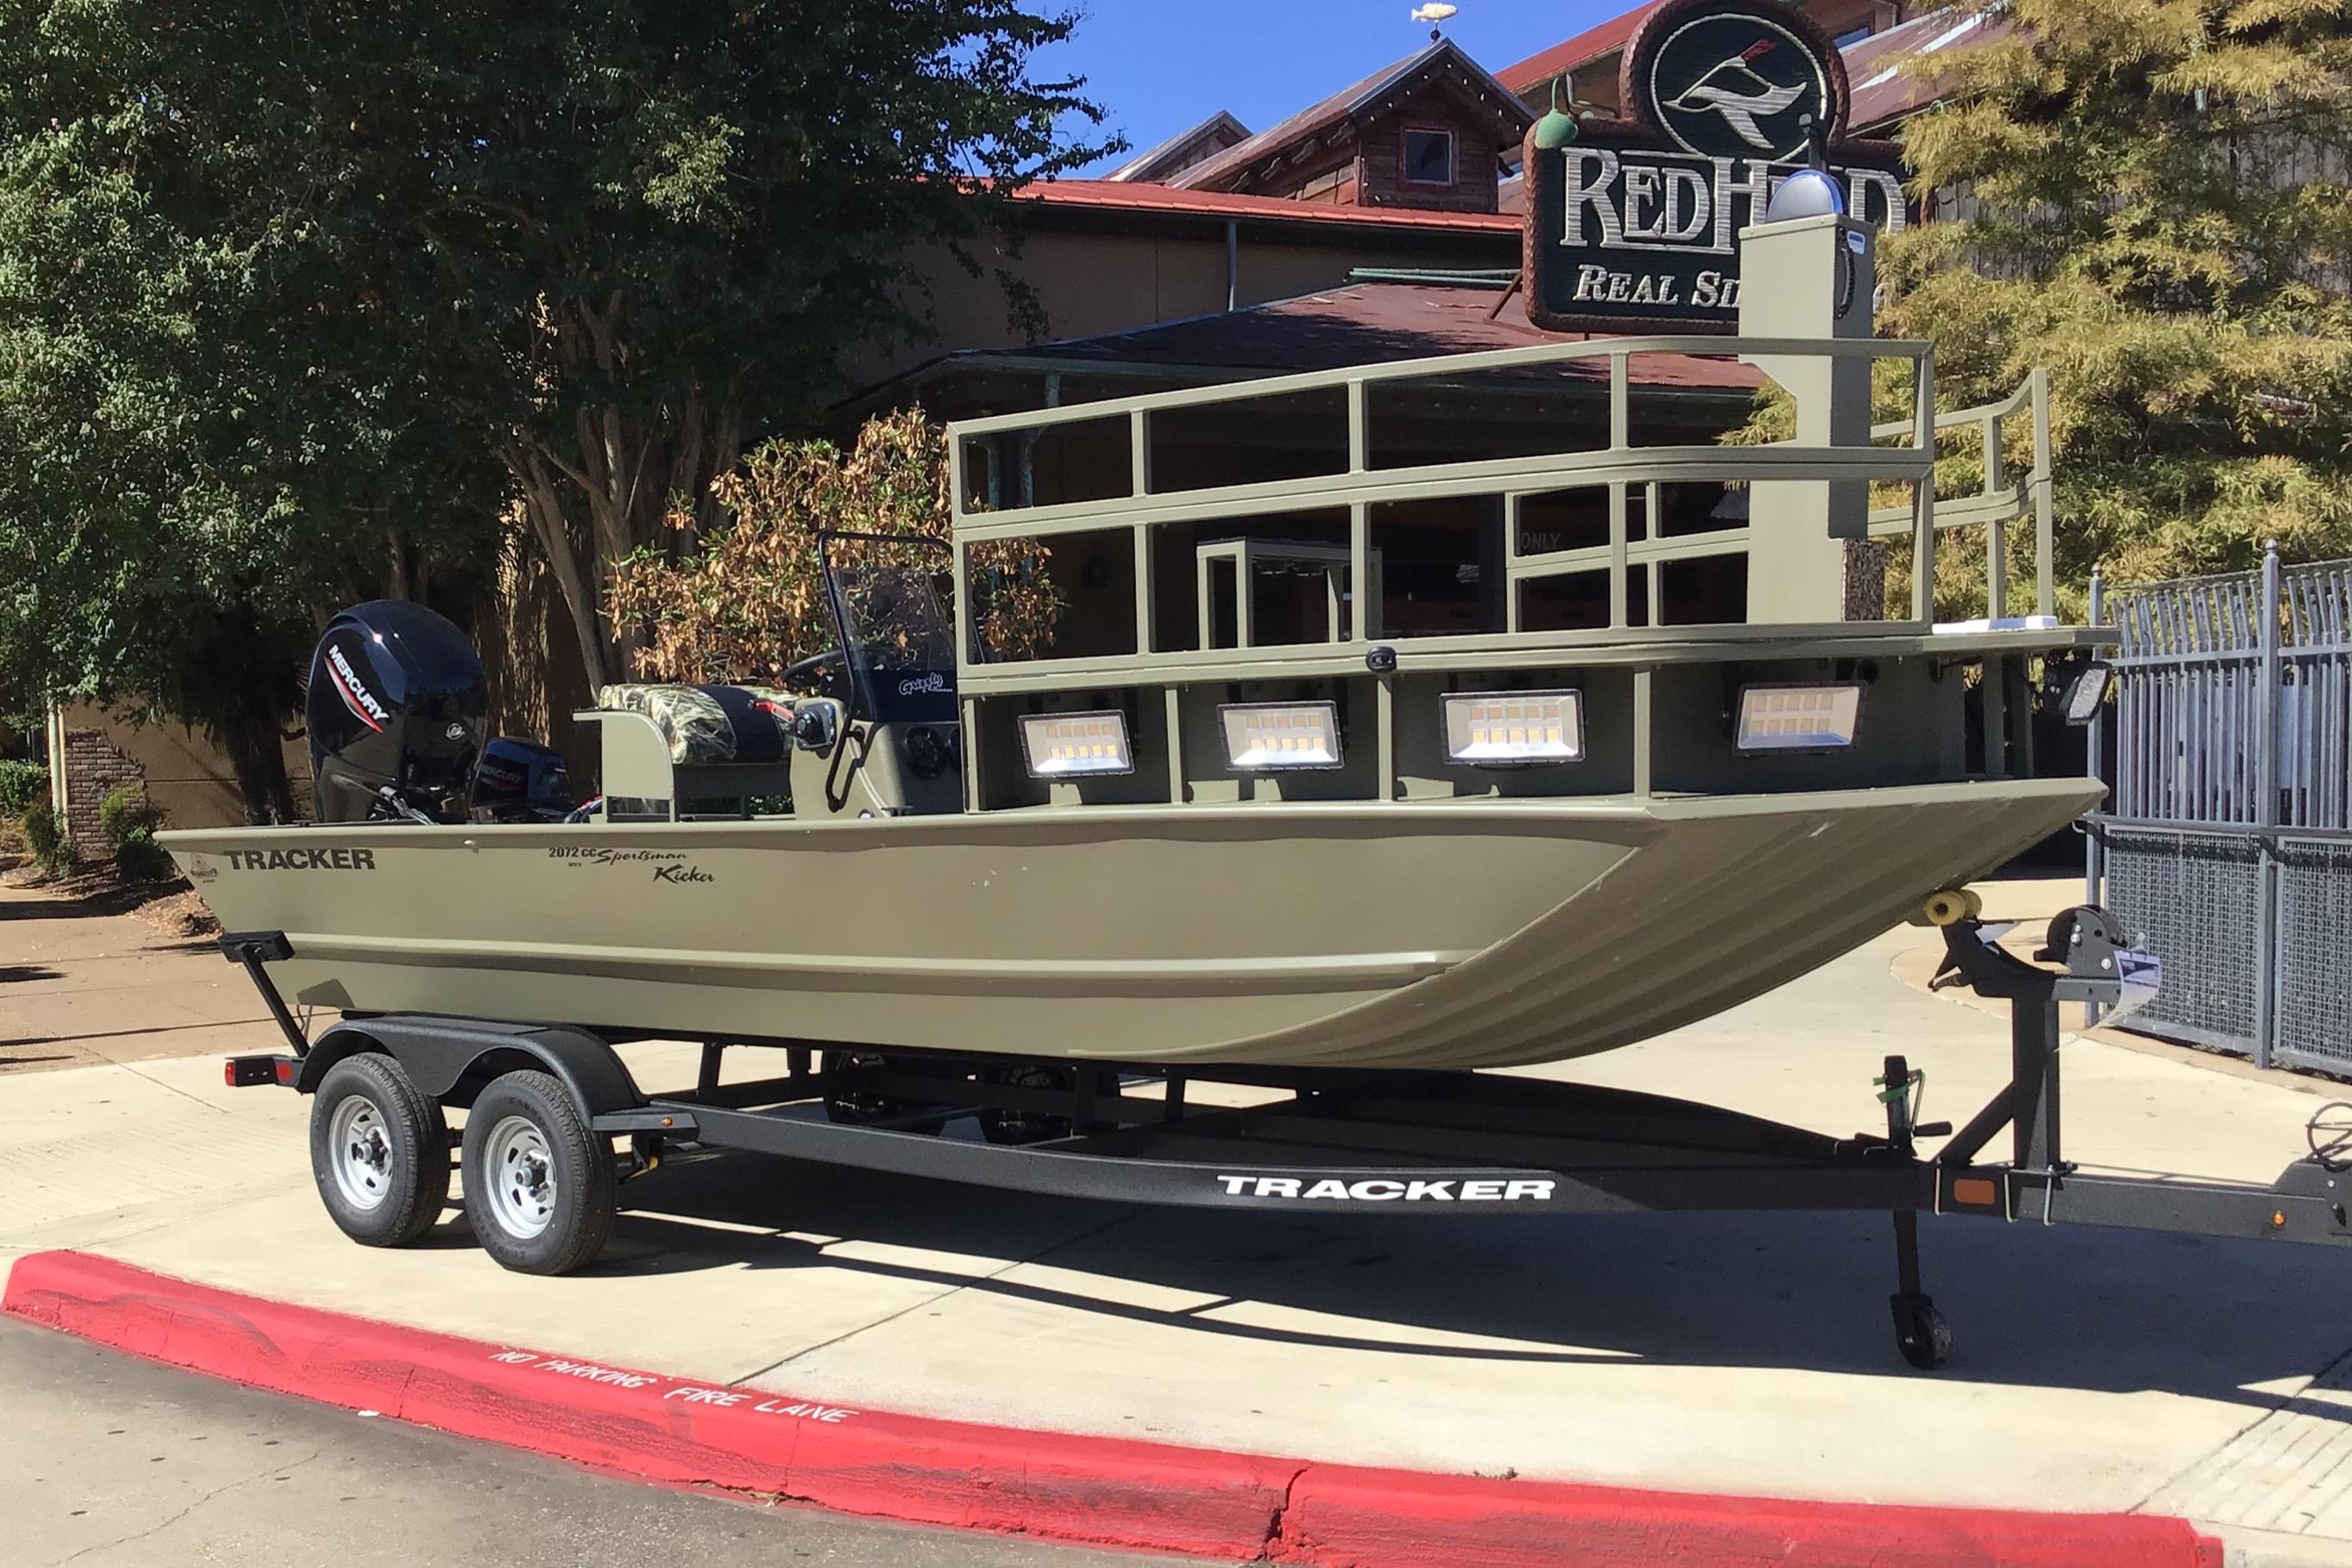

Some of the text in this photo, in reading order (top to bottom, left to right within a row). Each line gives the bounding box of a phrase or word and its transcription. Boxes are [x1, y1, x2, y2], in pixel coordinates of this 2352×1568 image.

[1560, 146, 1906, 255] REDHD
[1573, 263, 1679, 307] REAL
[1521, 531, 1561, 550] ONLY
[328, 644, 389, 722] MERCURY
[223, 848, 375, 871] TRACKER
[549, 846, 579, 858] 2072
[580, 847, 597, 858] CC
[592, 849, 688, 866] Sportsman
[653, 864, 717, 884] Kicker
[1216, 1174, 1556, 1201] TRACKER
[489, 1350, 860, 1423] NO PARKING FIRE LANE
